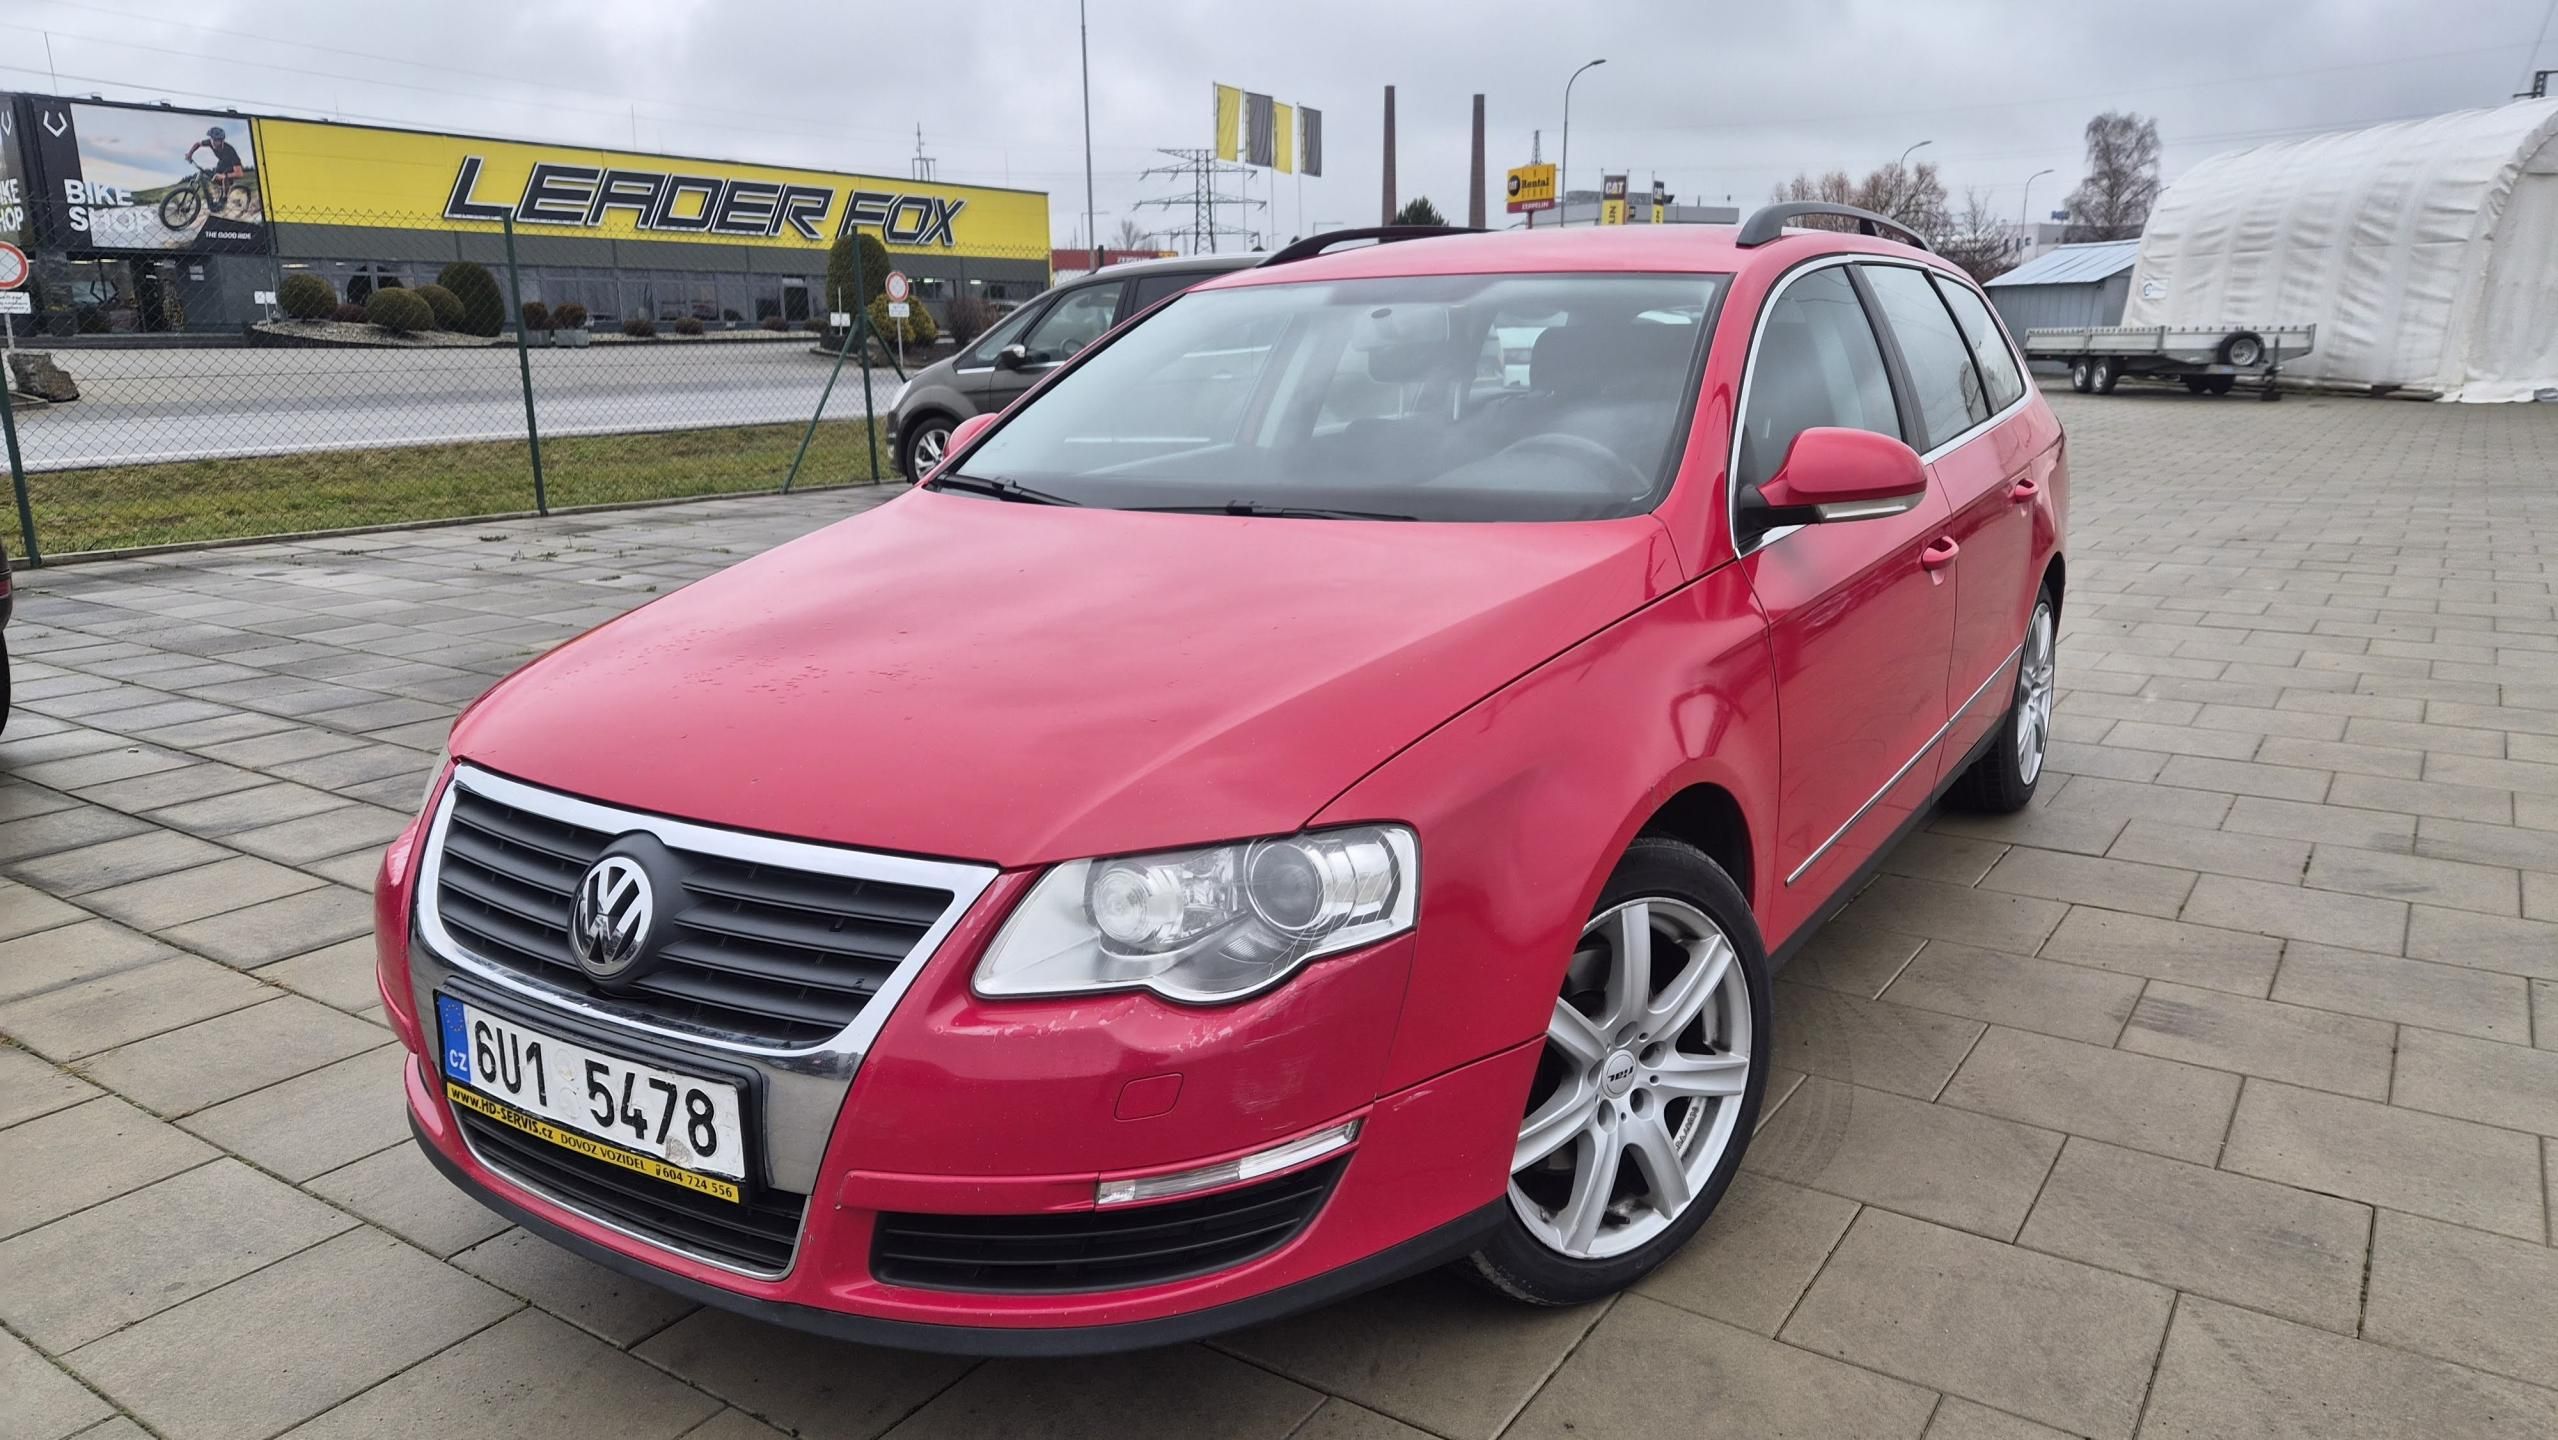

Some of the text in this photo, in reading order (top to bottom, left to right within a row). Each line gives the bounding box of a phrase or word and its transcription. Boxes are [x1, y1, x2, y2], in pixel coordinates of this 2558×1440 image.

[64, 178, 134, 206] BIKE
[1521, 177, 1549, 189] Rental
[1605, 181, 1625, 194] CAT
[443, 154, 967, 247] LEADER FOX
[68, 206, 154, 233] SHOP
[449, 1048, 468, 1072] CZ
[475, 1020, 718, 1158] 6U1 5478
[560, 1134, 598, 1155] DOVOZ
[599, 1146, 647, 1171] VOZIDEL
[662, 1167, 683, 1184] 604
[687, 1175, 708, 1191] 724
[711, 1183, 733, 1199] 556
